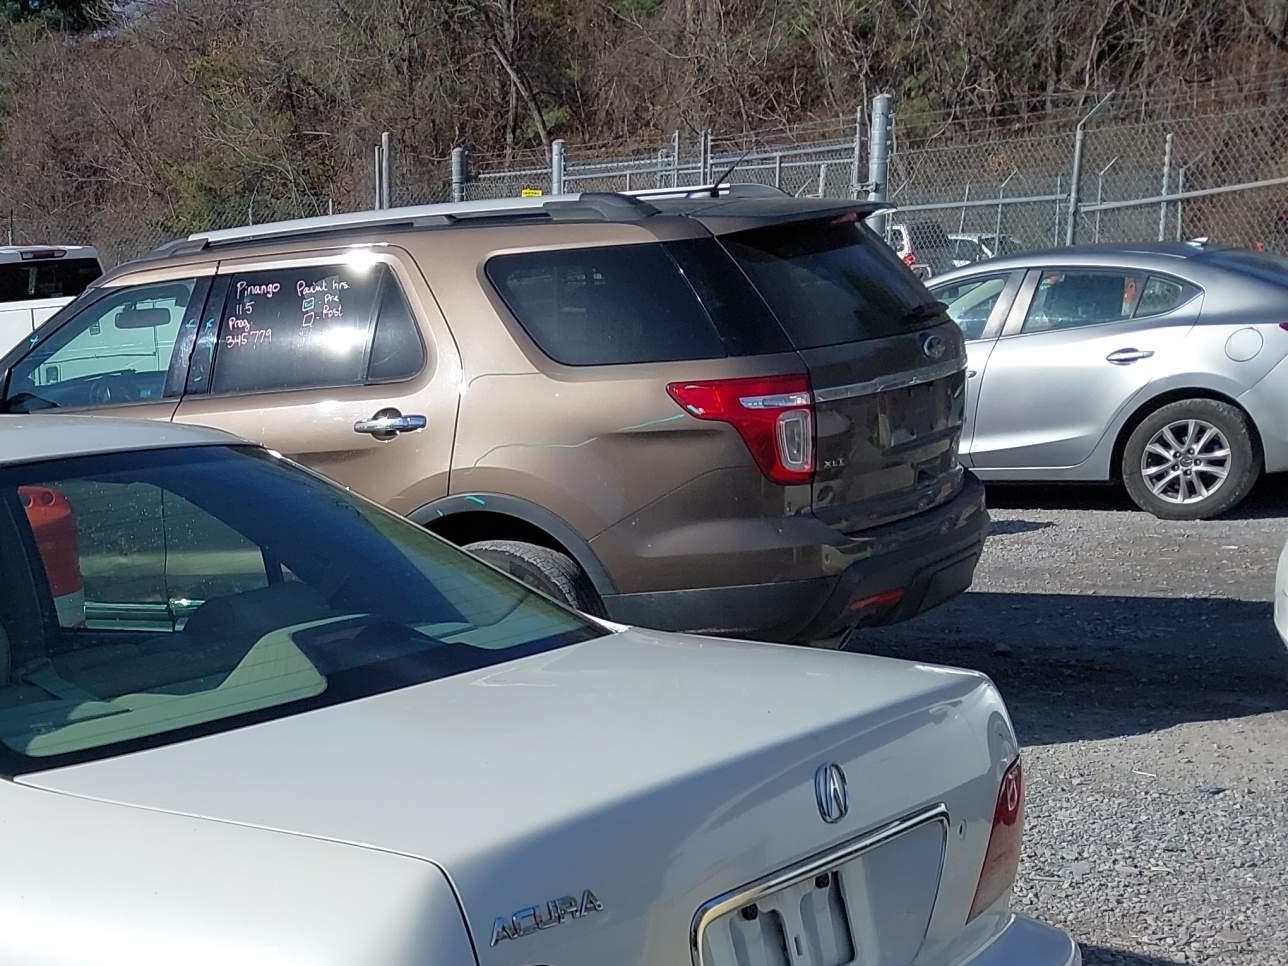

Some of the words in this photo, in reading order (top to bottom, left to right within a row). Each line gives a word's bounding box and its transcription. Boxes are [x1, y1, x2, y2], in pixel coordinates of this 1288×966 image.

[236, 280, 281, 300] Pinango
[296, 279, 329, 297] Paint
[324, 293, 340, 305] Pre
[322, 304, 344, 320] Post
[489, 888, 605, 948] ACURA
